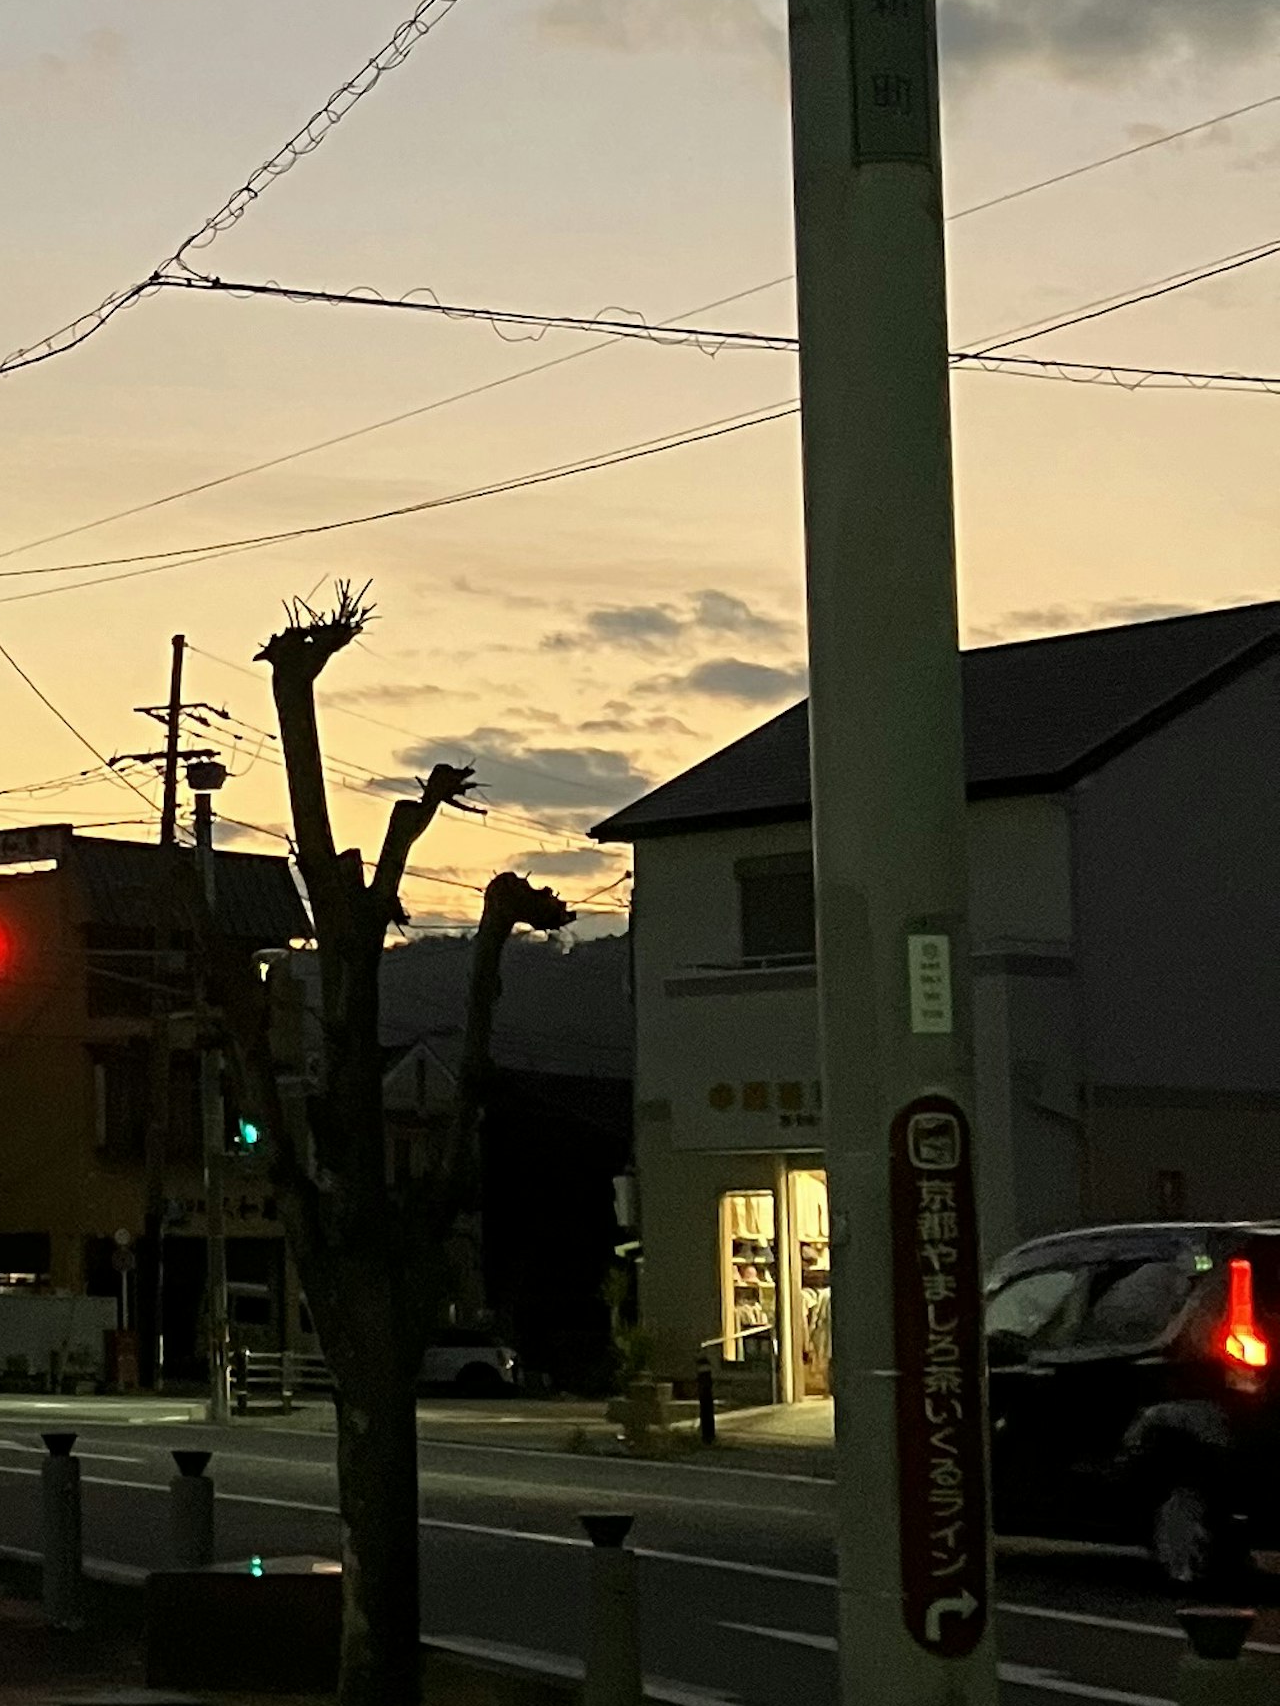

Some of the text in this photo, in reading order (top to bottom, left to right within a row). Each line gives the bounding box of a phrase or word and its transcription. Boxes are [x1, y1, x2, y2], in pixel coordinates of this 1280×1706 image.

[915, 1177, 969, 1578] 京都やましろ茶いくるライン
